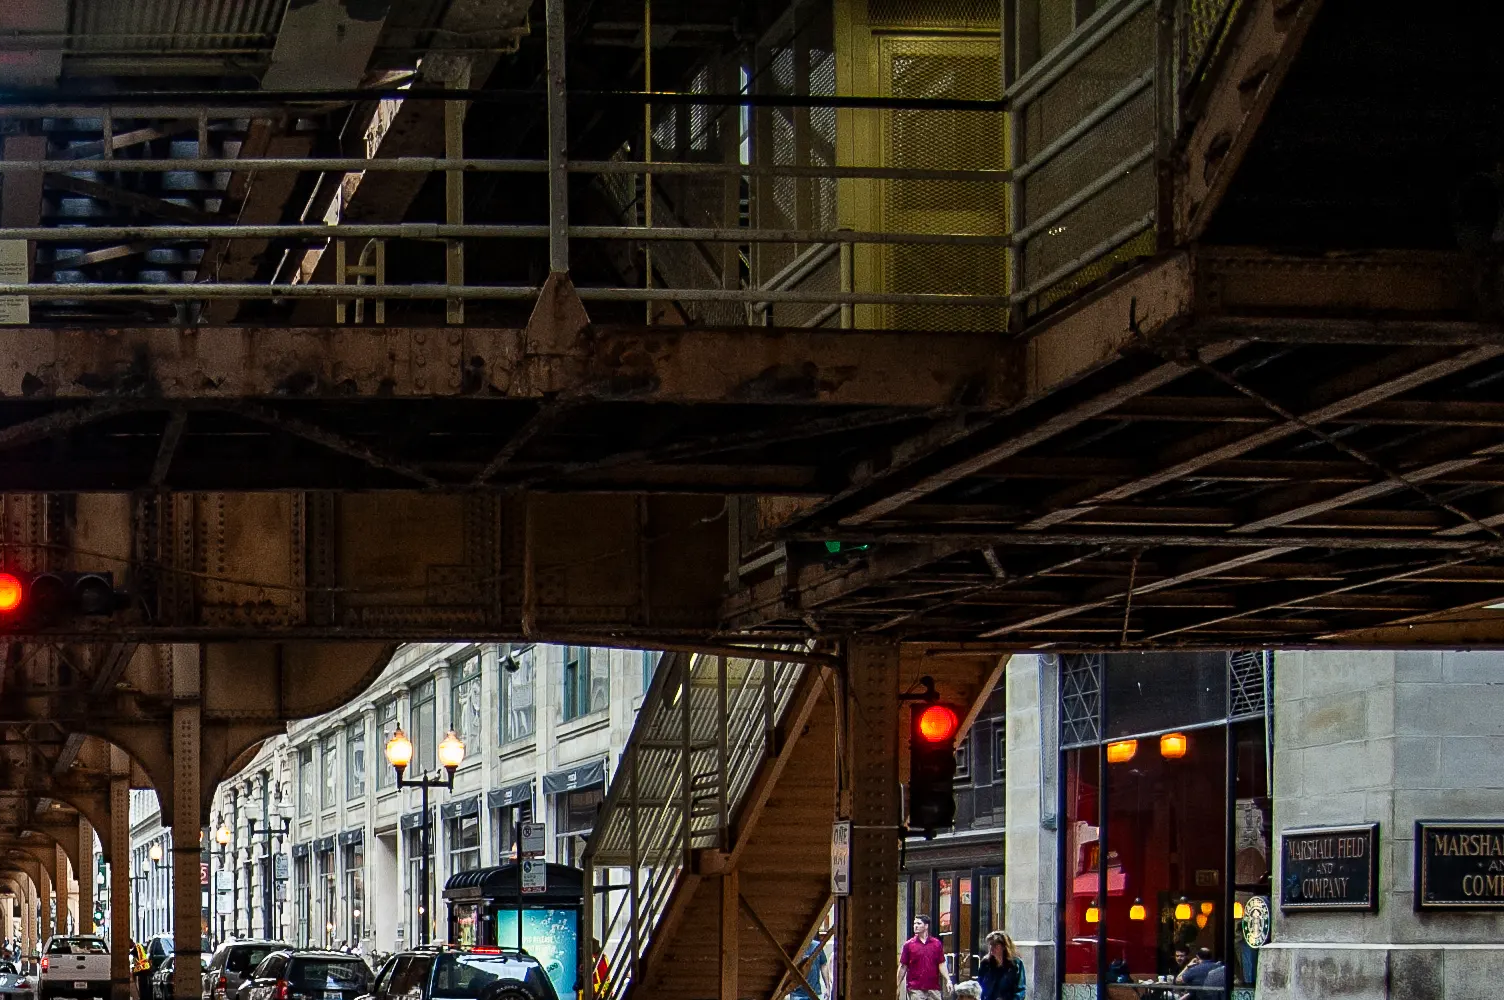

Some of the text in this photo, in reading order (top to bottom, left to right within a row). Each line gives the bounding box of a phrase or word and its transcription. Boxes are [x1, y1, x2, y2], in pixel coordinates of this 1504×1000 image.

[1288, 836, 1364, 860] MARSHALL FIELD
[1435, 834, 1504, 856] MARSHA
[1316, 862, 1334, 875] AND
[1302, 876, 1350, 899] COMPANY
